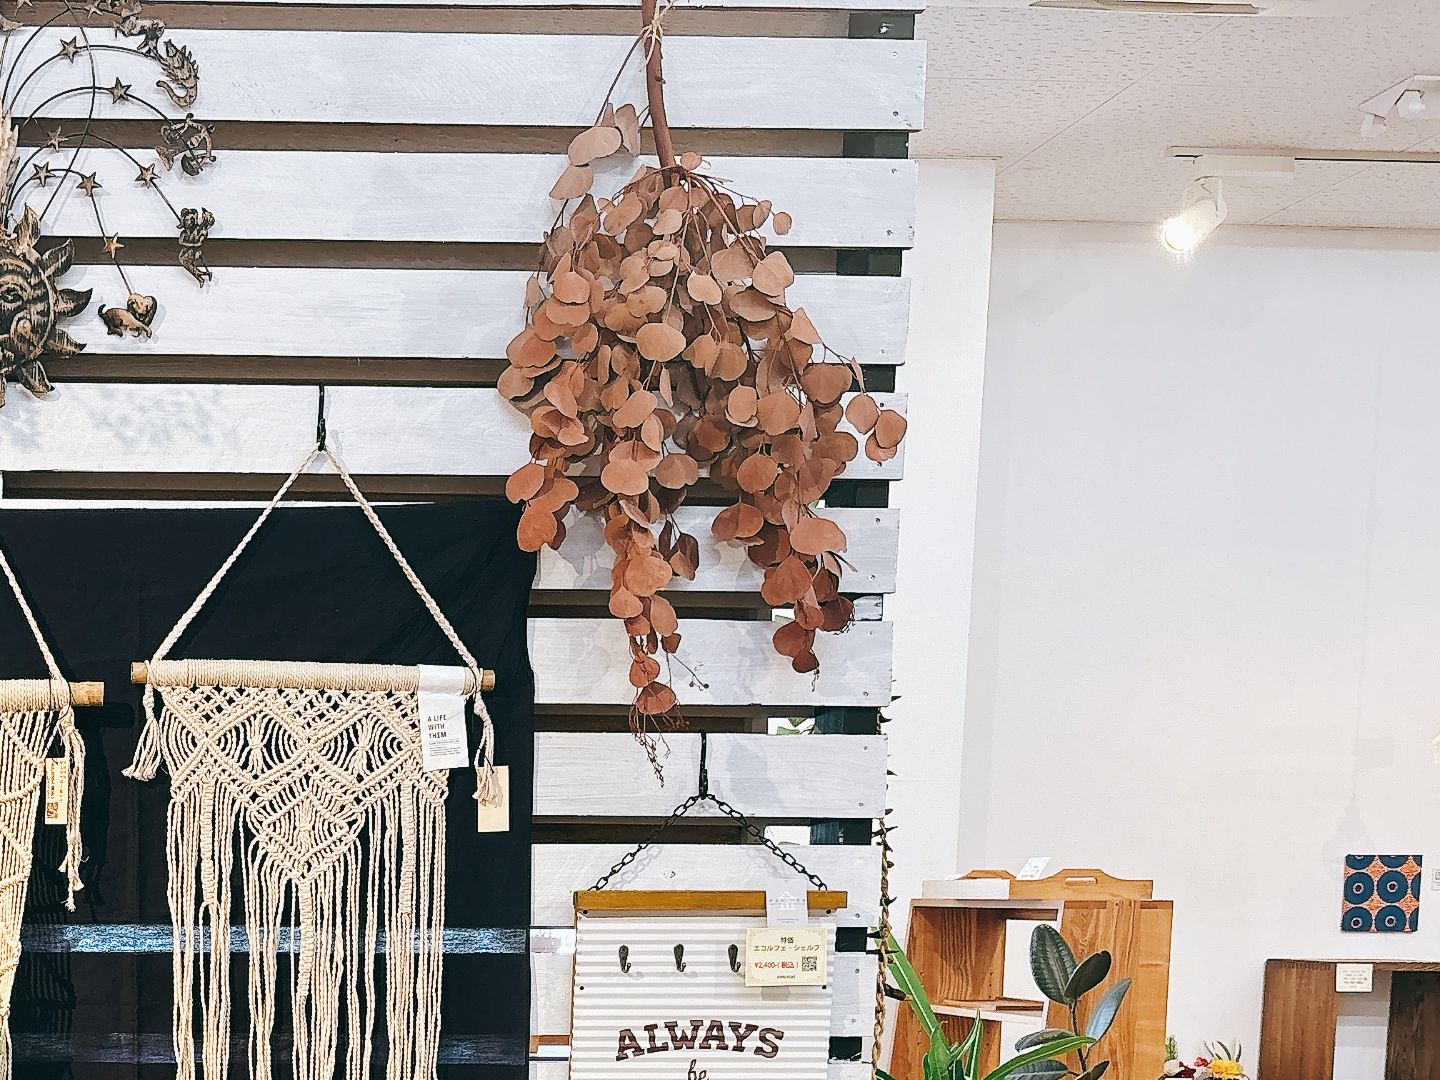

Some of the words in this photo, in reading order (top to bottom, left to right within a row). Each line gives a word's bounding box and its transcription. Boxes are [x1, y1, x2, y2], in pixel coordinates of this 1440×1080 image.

[427, 723, 445, 731] WITH
[428, 731, 447, 739] THEM
[615, 1019, 785, 1061] ALWAYS
